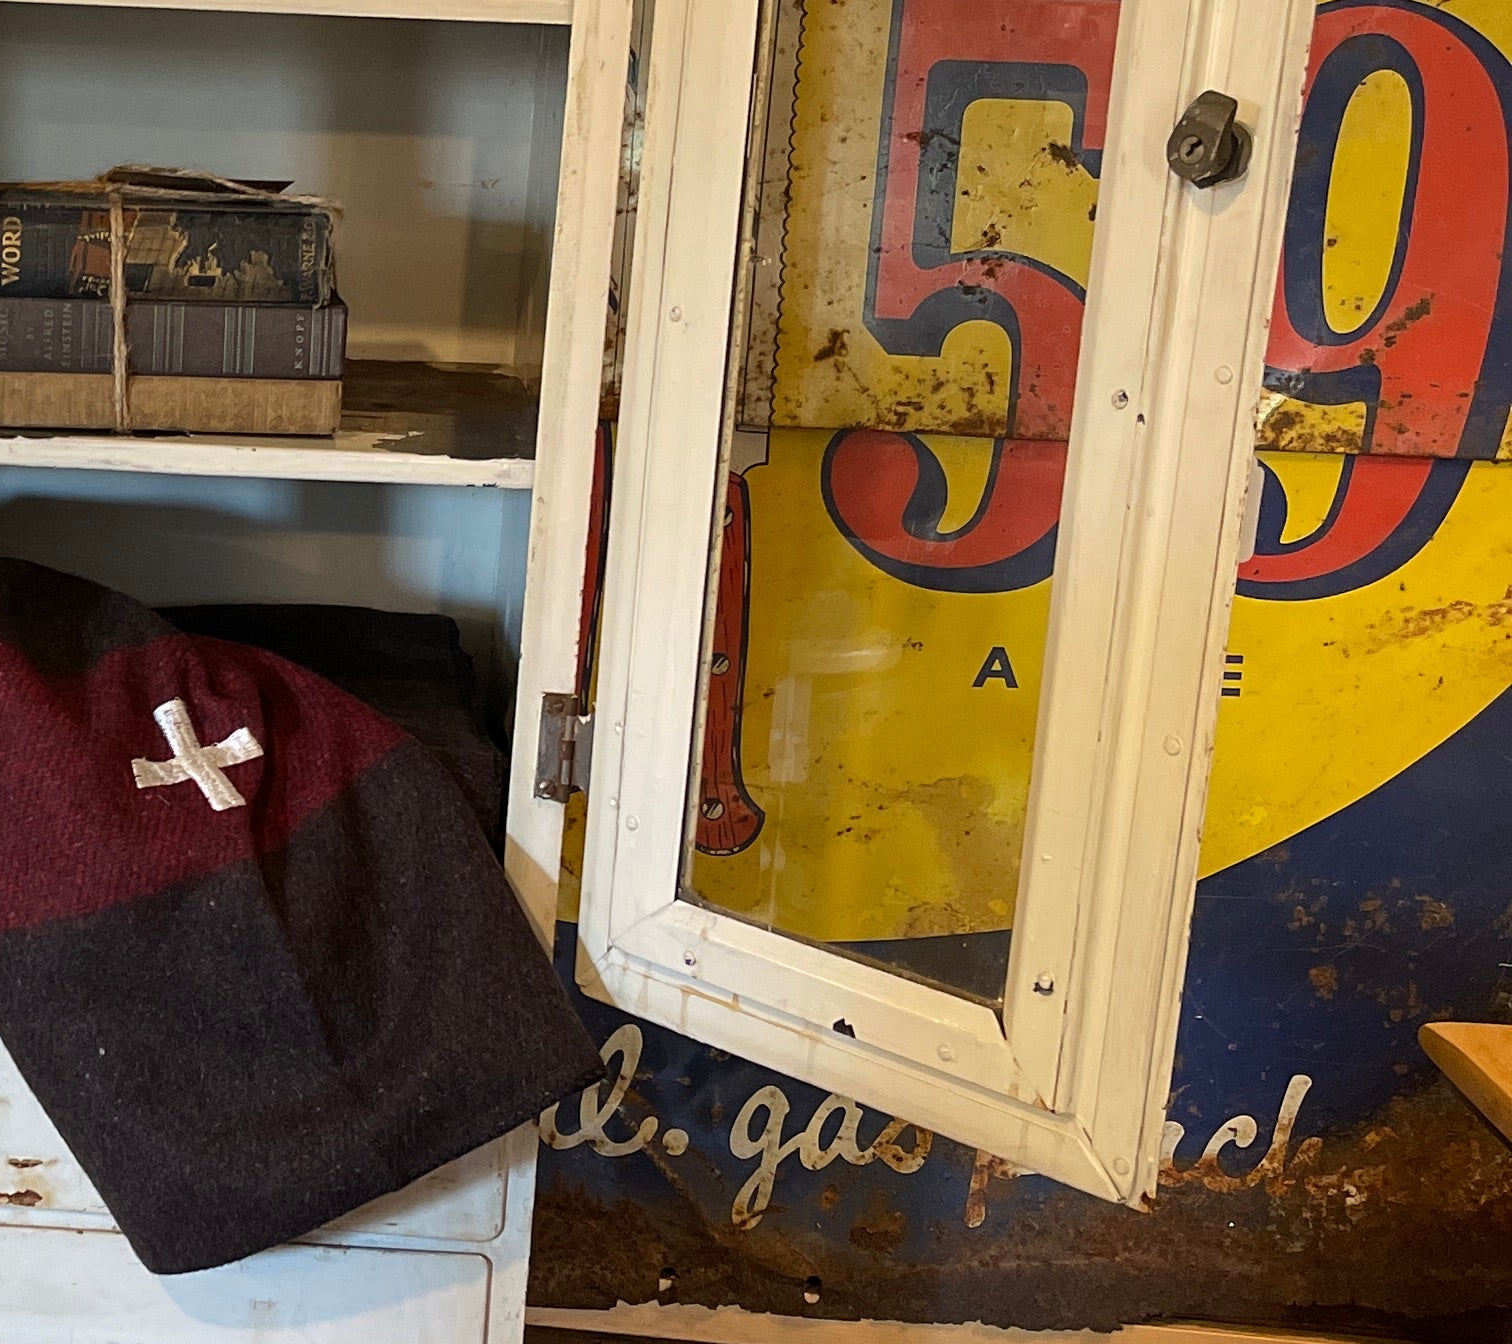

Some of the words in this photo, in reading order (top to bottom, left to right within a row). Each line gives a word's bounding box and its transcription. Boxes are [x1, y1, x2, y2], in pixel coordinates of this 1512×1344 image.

[1, 216, 22, 286] WORD
[43, 309, 55, 361] ALFRED
[61, 303, 73, 368] EINSTEIN
[294, 312, 306, 370] KNOPF
[971, 646, 1019, 689] A
[729, 1084, 934, 1231] gas
